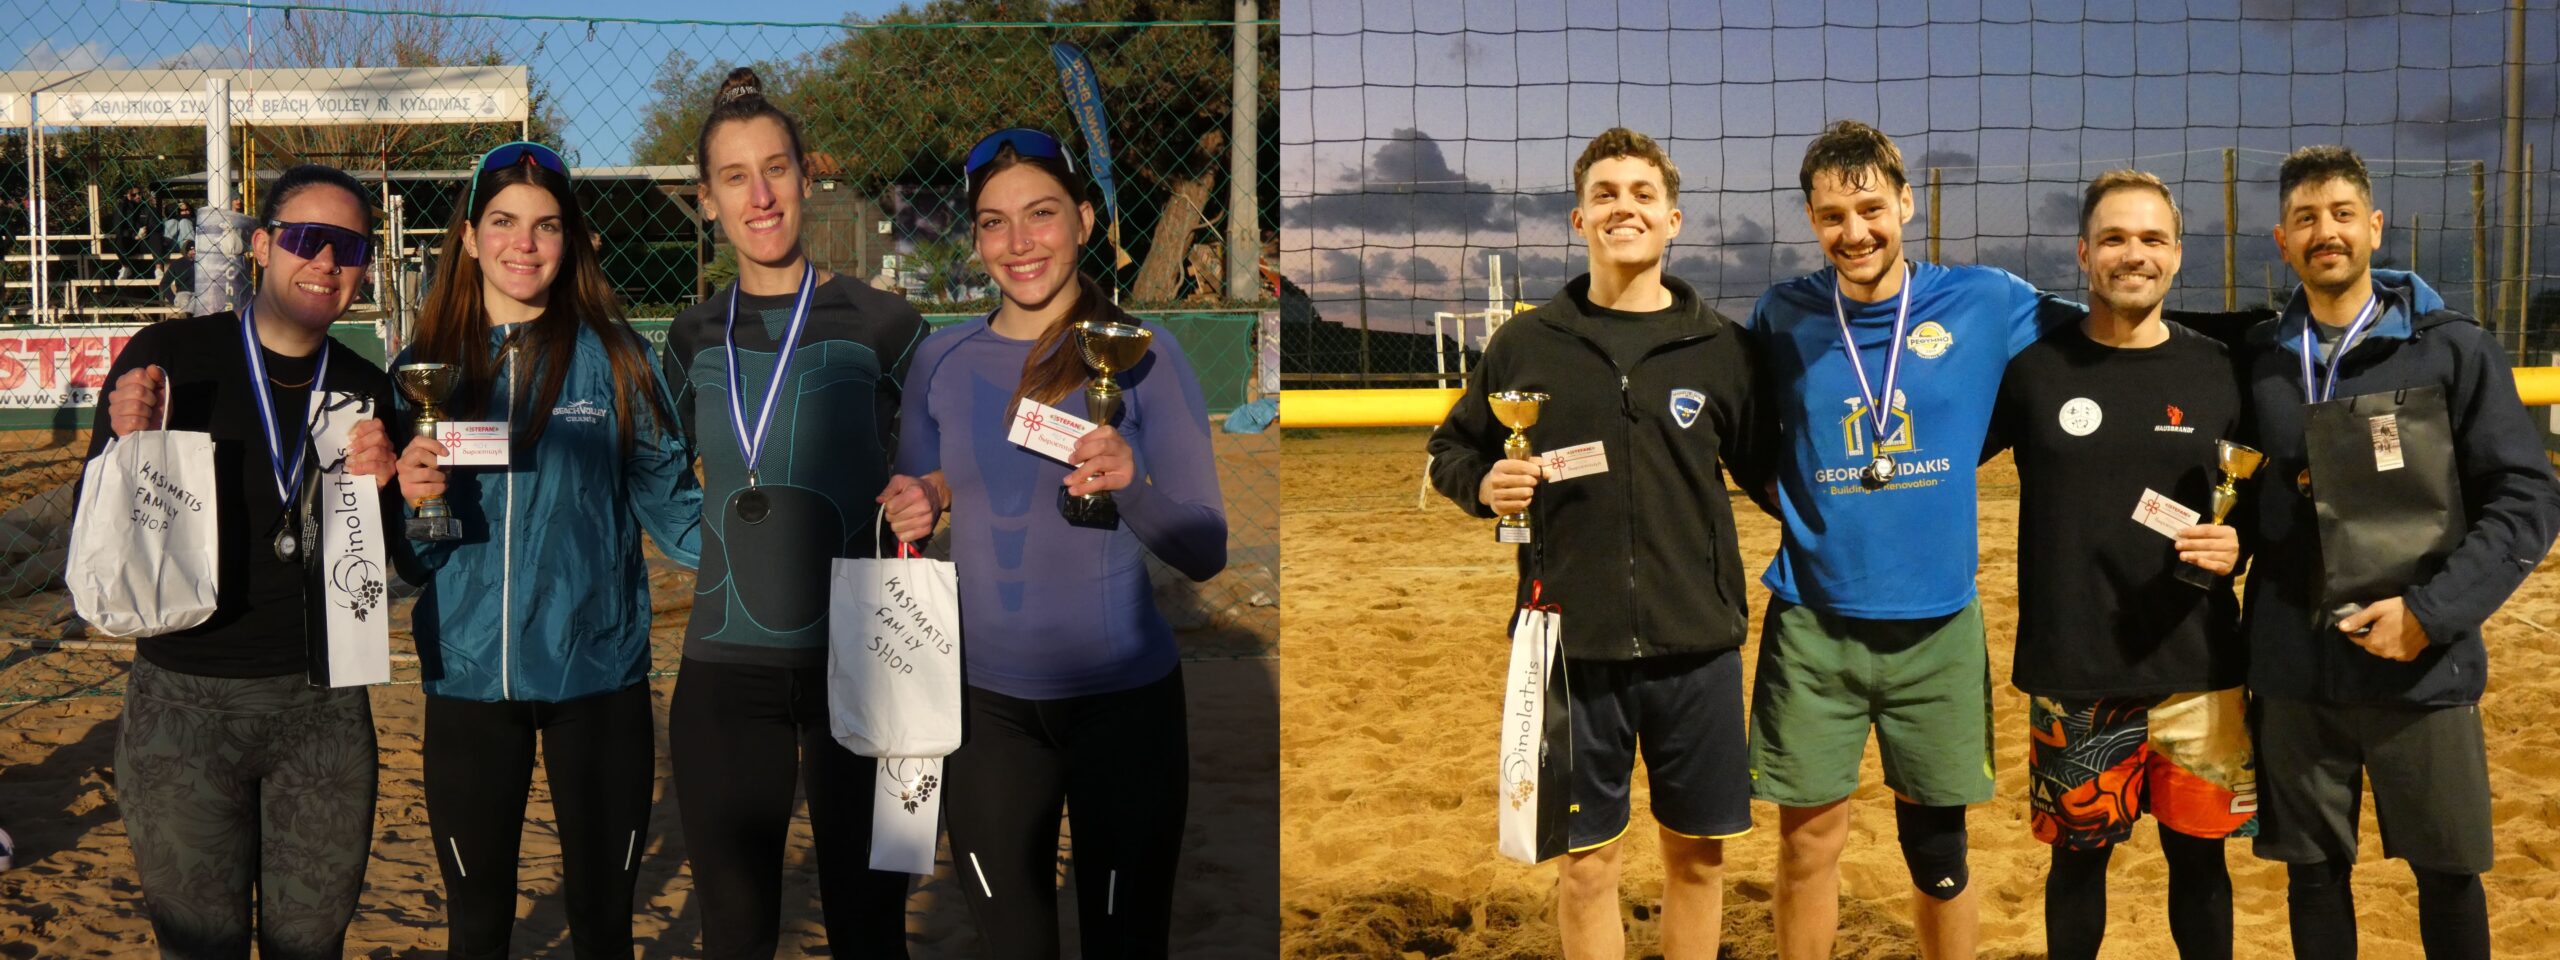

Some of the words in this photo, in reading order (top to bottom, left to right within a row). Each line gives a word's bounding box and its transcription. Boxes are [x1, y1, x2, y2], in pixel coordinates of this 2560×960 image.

[262, 99, 309, 113] BEACH
[316, 98, 370, 112] VOLLEY
[0, 390, 101, 405] www.ste
[2154, 425, 2195, 434] HAUSBRANDT
[135, 486, 179, 521] FAMILY
[139, 461, 202, 512] KASIMATIS
[130, 509, 169, 533] SHOP
[875, 607, 924, 651] FAMILY
[885, 576, 953, 655] KASIMATIS
[866, 636, 913, 675] SHOP
